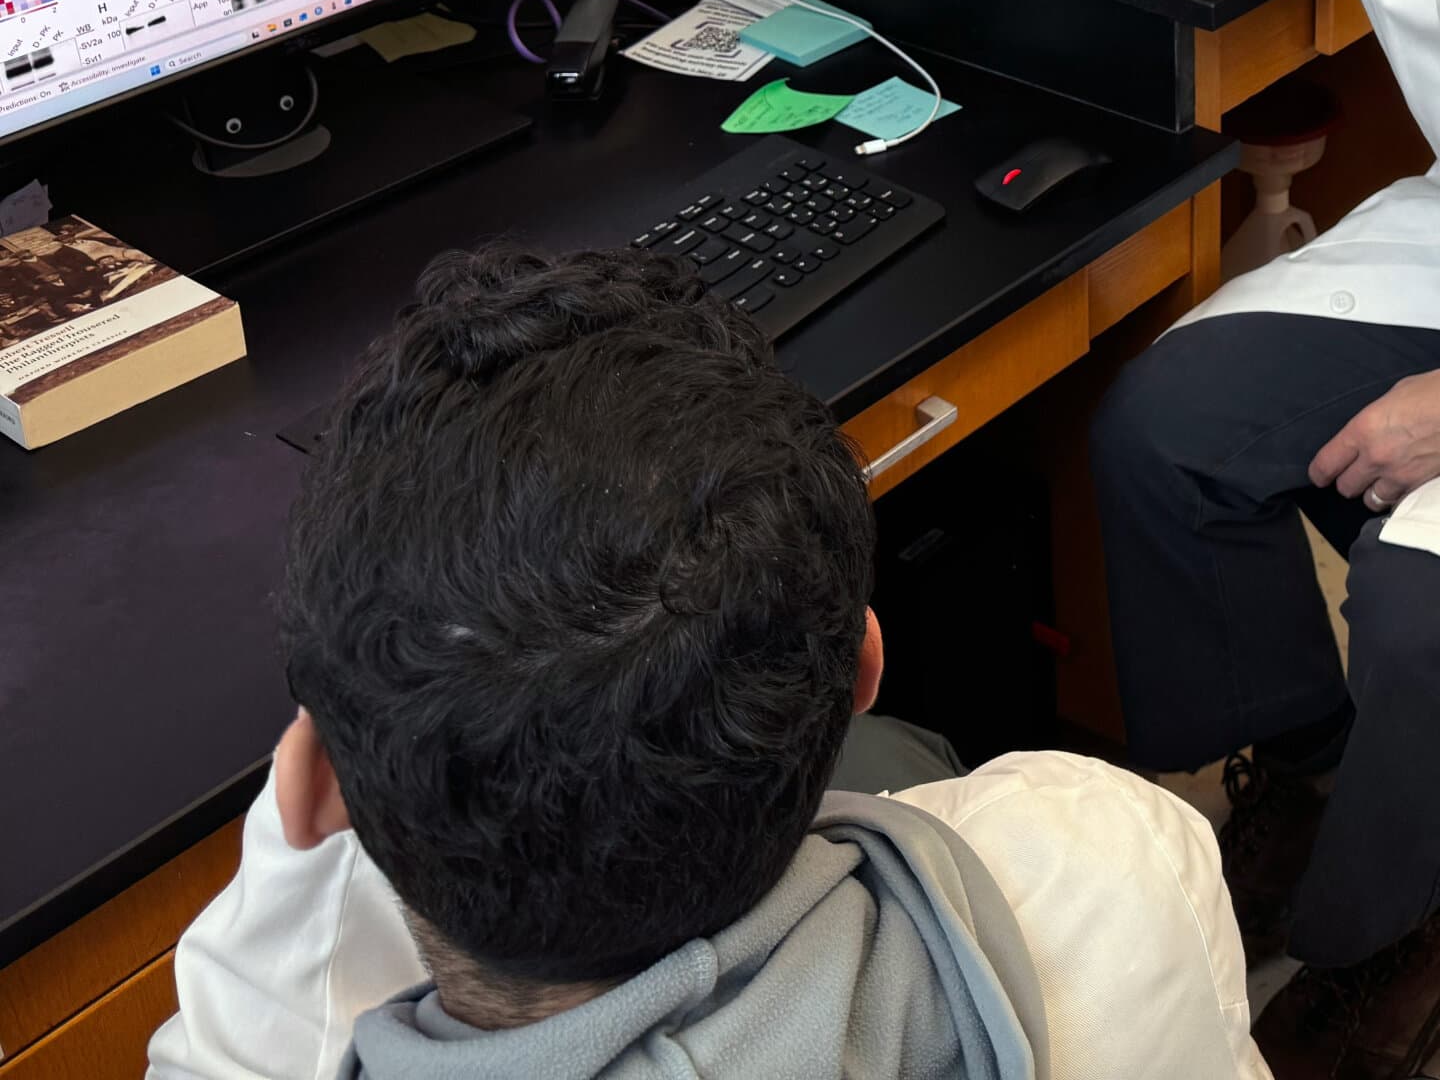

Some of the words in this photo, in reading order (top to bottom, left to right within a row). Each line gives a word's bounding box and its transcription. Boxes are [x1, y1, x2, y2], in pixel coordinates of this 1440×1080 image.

[98, 3, 107, 14] H
[40, 90, 51, 98] On
[0, 345, 33, 361] obert
[34, 325, 75, 344] Tressell
[7, 333, 95, 374] Philanthropists
